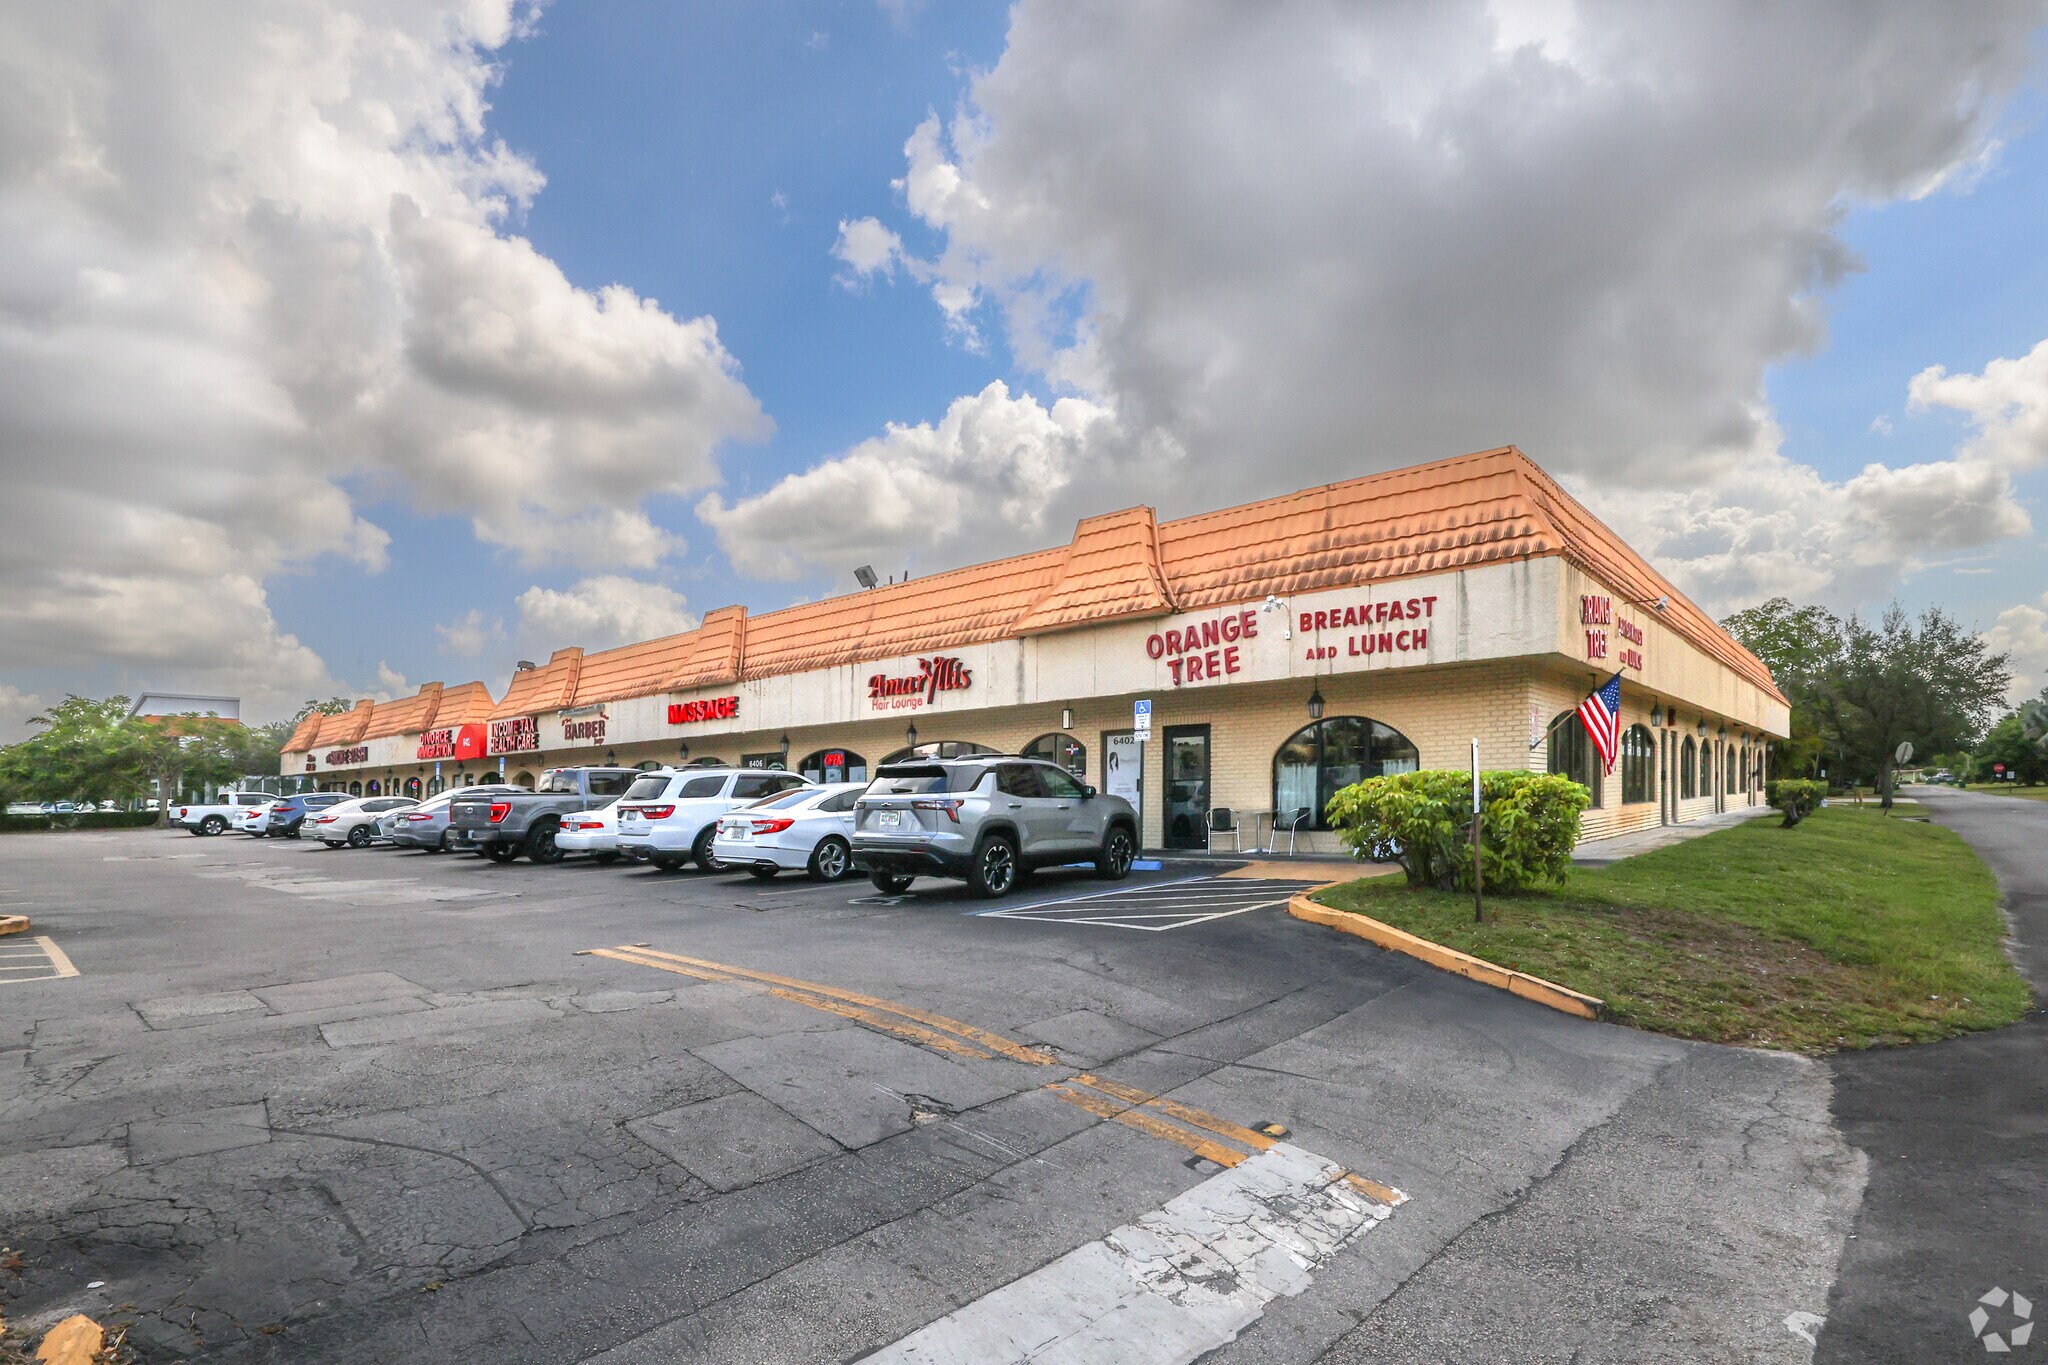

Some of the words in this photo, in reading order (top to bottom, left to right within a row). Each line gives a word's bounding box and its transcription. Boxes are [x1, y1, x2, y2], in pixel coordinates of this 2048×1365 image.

[1300, 596, 1437, 632] BREAKFAST
[1146, 610, 1257, 659] ORANGE
[1306, 646, 1337, 660] AND
[1349, 629, 1427, 656] LUNCH
[1167, 646, 1240, 685] TREE
[668, 696, 737, 724] MASSAGE
[872, 699, 889, 710] Hair
[892, 697, 922, 710] Lounge
[492, 719, 518, 737] INCOME
[521, 717, 535, 733] TAX
[565, 720, 605, 740] BARBER
[420, 730, 450, 745] DIVORCE
[491, 735, 515, 753] HEALTH
[517, 733, 536, 750] CARE
[1113, 737, 1135, 745] 6402
[824, 753, 843, 766] OPEN
